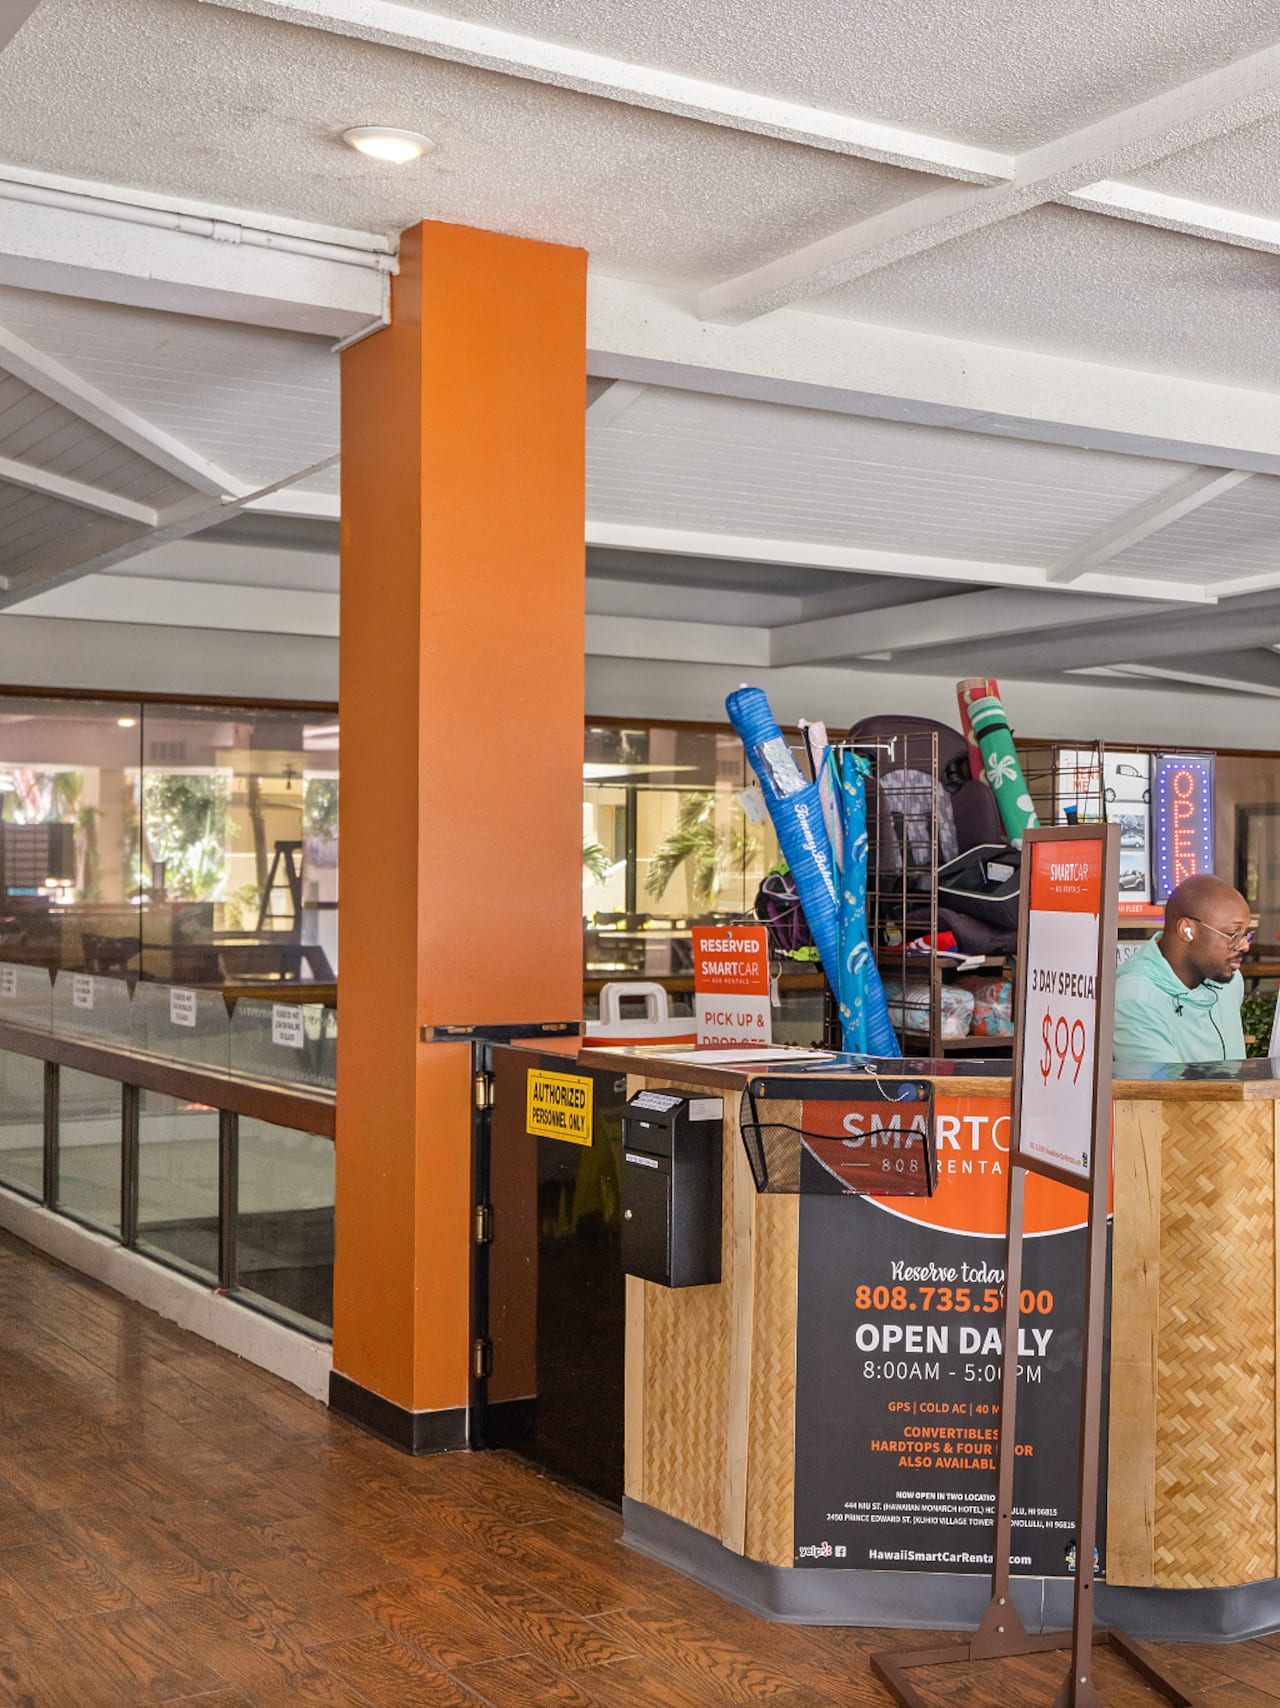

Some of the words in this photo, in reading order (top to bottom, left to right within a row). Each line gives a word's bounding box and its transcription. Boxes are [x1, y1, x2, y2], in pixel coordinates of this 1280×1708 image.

[1173, 770, 1196, 887] OPEN
[1050, 864, 1088, 881] SMARTCAR
[1126, 904, 1143, 912] FLEET
[700, 939, 760, 953] RESERVED
[701, 961, 759, 976] SMARTCAR
[1032, 969, 1037, 990] 3
[1039, 971, 1057, 993] DAY
[1058, 973, 1096, 1000] SPECIA
[705, 1012, 733, 1026] PICK
[737, 1013, 753, 1027] UP
[756, 1014, 765, 1027] &
[1040, 1005, 1086, 1087] $99
[533, 1082, 586, 1109] AUTHORIZED
[532, 1107, 567, 1128] PERSONNEL
[569, 1114, 586, 1132] ONLY
[842, 1113, 1011, 1151] SMARTC
[882, 1158, 919, 1173] 808
[936, 1160, 1004, 1175] RENTA
[891, 1261, 958, 1282] Reserve
[855, 1285, 1054, 1315] 808.735.500
[855, 1324, 949, 1354] OPEN
[959, 1327, 1054, 1357] DALY
[863, 1361, 940, 1381] 8:00AM
[888, 1401, 911, 1413] GPS
[920, 1402, 948, 1414] COLD
[952, 1403, 967, 1414] AC
[976, 1404, 990, 1415] 40
[904, 1427, 998, 1441] CONVERTIBLES
[871, 1441, 939, 1454] HARDTOPS
[943, 1442, 952, 1454] &
[956, 1443, 992, 1455] FOUR
[995, 1445, 1034, 1457] OR
[898, 1456, 932, 1468] ALSO
[935, 1458, 996, 1470] AVAILABL
[896, 1491, 914, 1499] NOW
[915, 1492, 936, 1500] OPEN
[937, 1492, 945, 1500] IN
[946, 1493, 963, 1501] TWO
[964, 1494, 996, 1502] LOCATIO
[872, 1503, 882, 1511] ST.
[921, 1504, 957, 1513] MONARCH
[958, 1505, 984, 1515] HOTEL)
[986, 1507, 1027, 1516] HOULU,
[1028, 1508, 1036, 1516] HI
[844, 1514, 869, 1522] PRINCE
[871, 1515, 901, 1523] EDWARD
[902, 1516, 912, 1524] ST.
[939, 1517, 968, 1526] VILLAGE
[969, 1518, 995, 1527] TOWER
[1010, 1520, 1044, 1529] ONOLULU,
[800, 1545, 822, 1559] yelp
[869, 1549, 1033, 1566] HawaiiSmartCarRentacom
